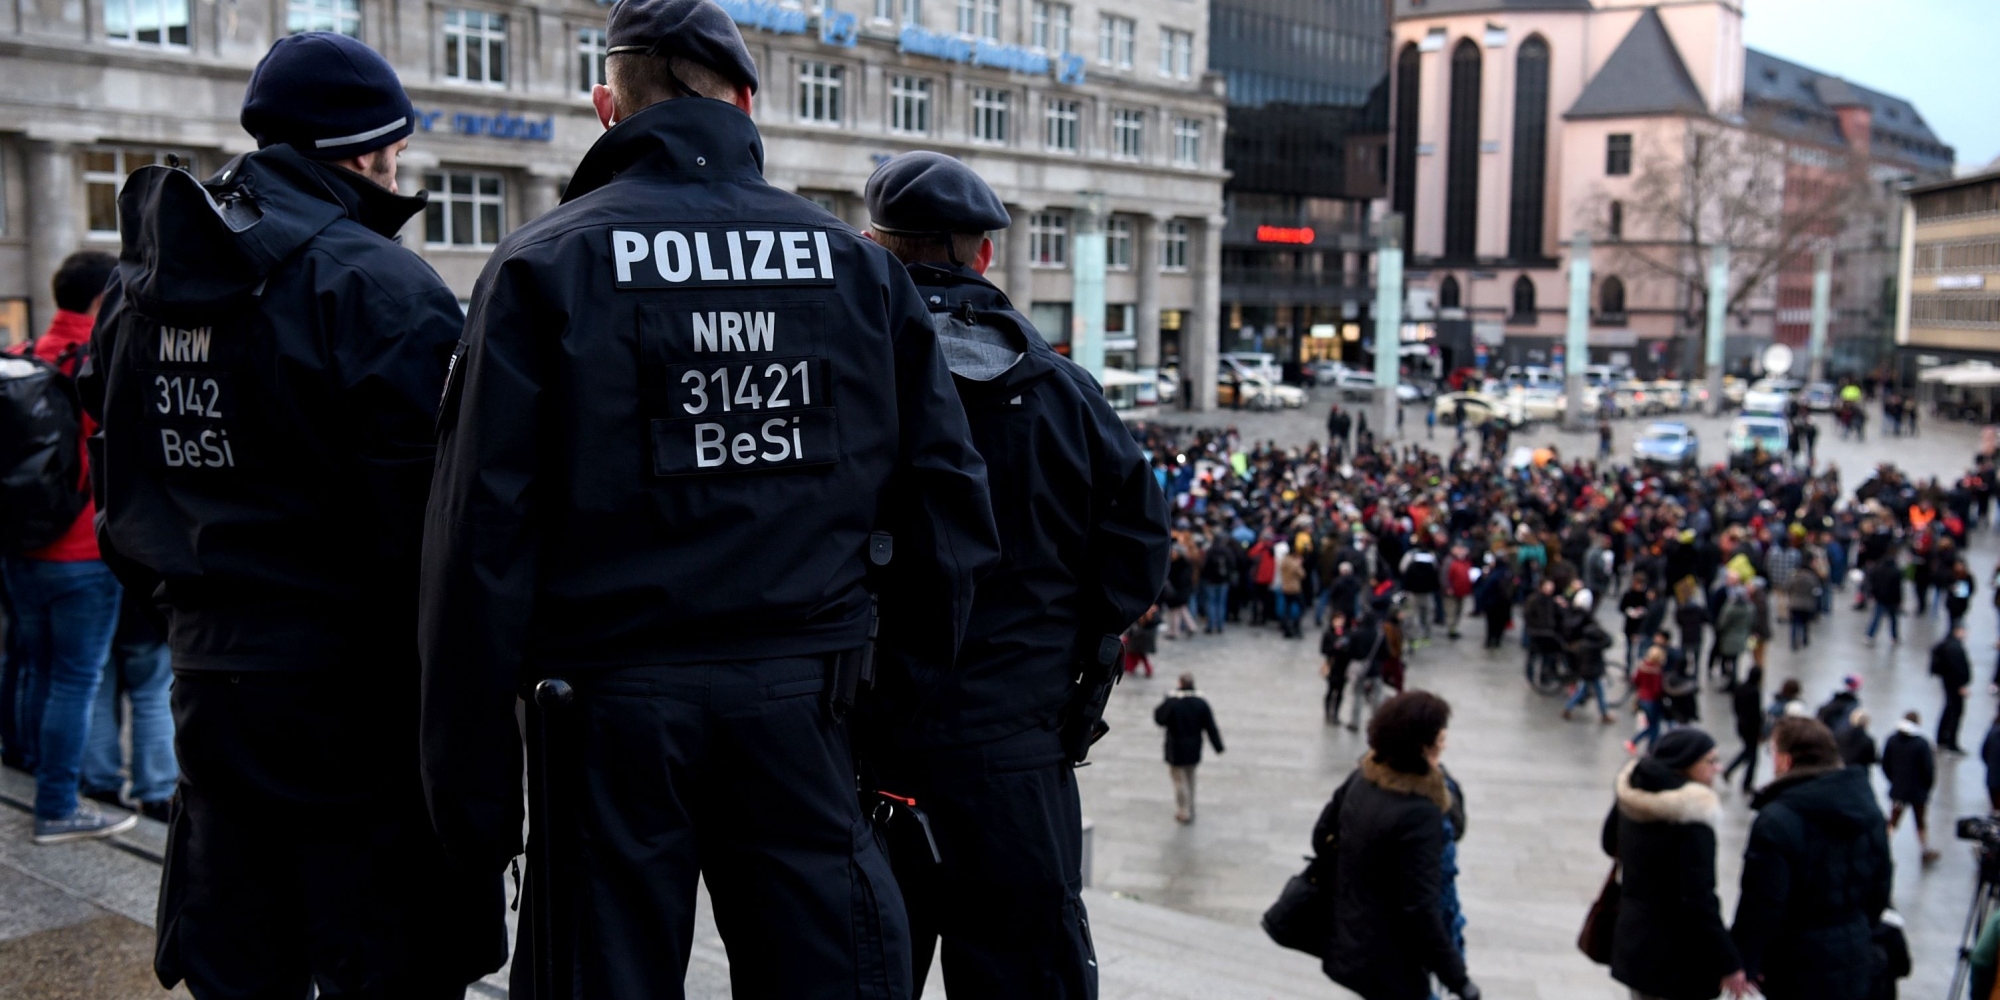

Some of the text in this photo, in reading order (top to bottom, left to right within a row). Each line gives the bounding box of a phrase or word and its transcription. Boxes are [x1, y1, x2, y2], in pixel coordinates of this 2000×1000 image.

[612, 230, 835, 282] POLIZEI
[159, 325, 212, 362] NRW
[692, 311, 776, 352] NRW
[155, 375, 222, 418] 3142
[681, 360, 811, 415] 31421
[161, 429, 235, 468] BeSi
[694, 416, 803, 468] BeSi
